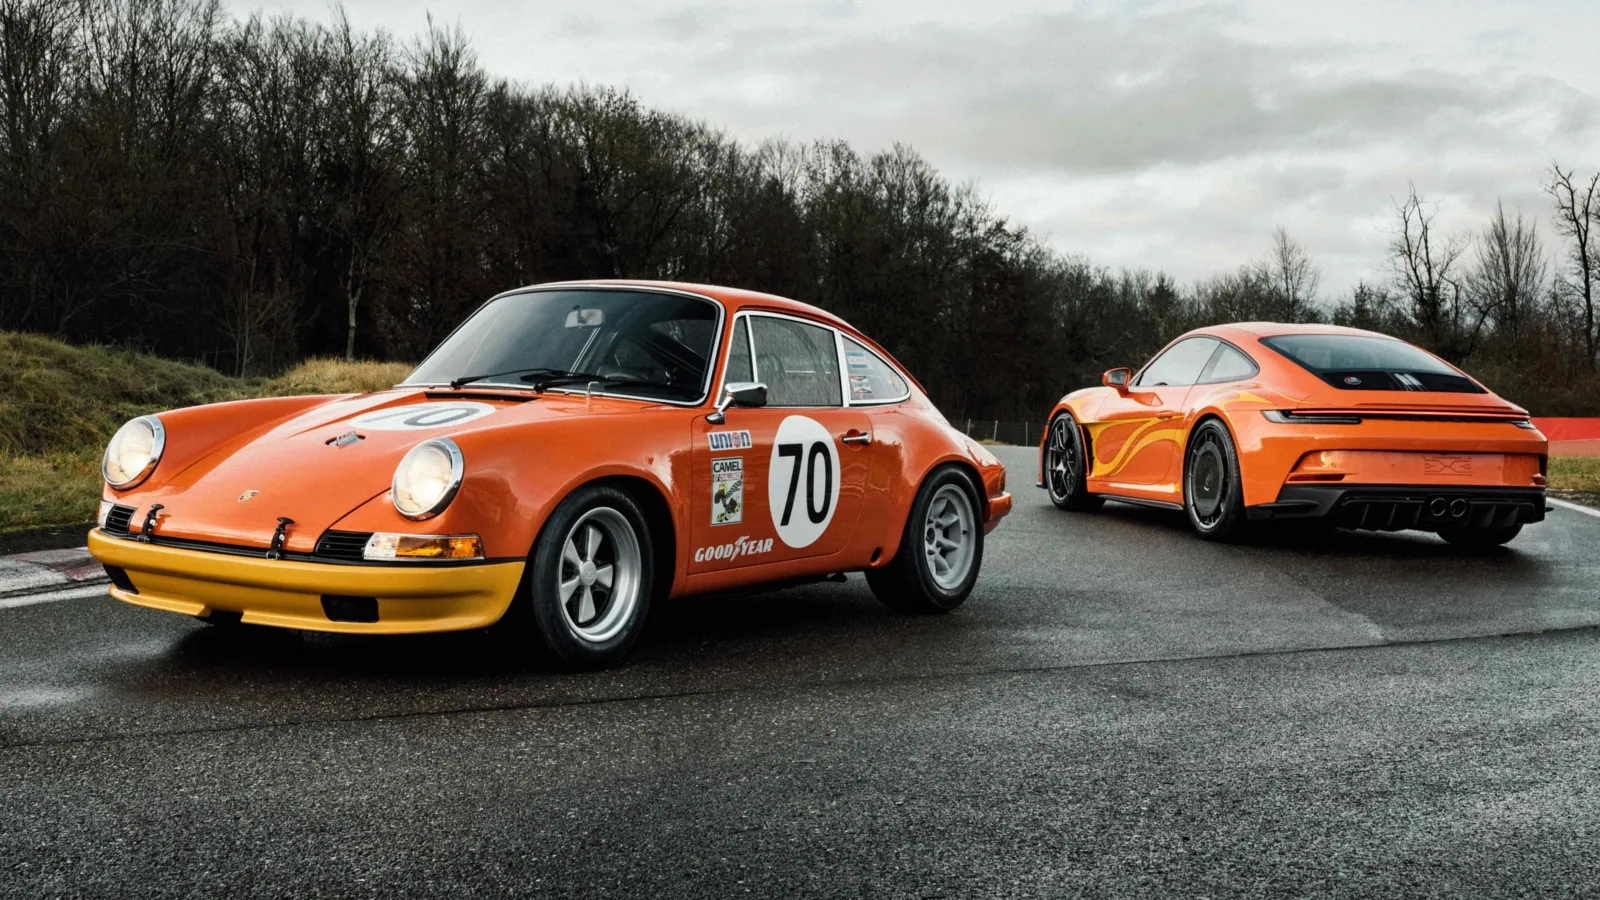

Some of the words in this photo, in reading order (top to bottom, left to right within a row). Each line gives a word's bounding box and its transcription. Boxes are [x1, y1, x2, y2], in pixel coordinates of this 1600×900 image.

[713, 461, 742, 473] CAMEL
[778, 441, 832, 526] 70
[695, 535, 774, 562] GOODYEAR
